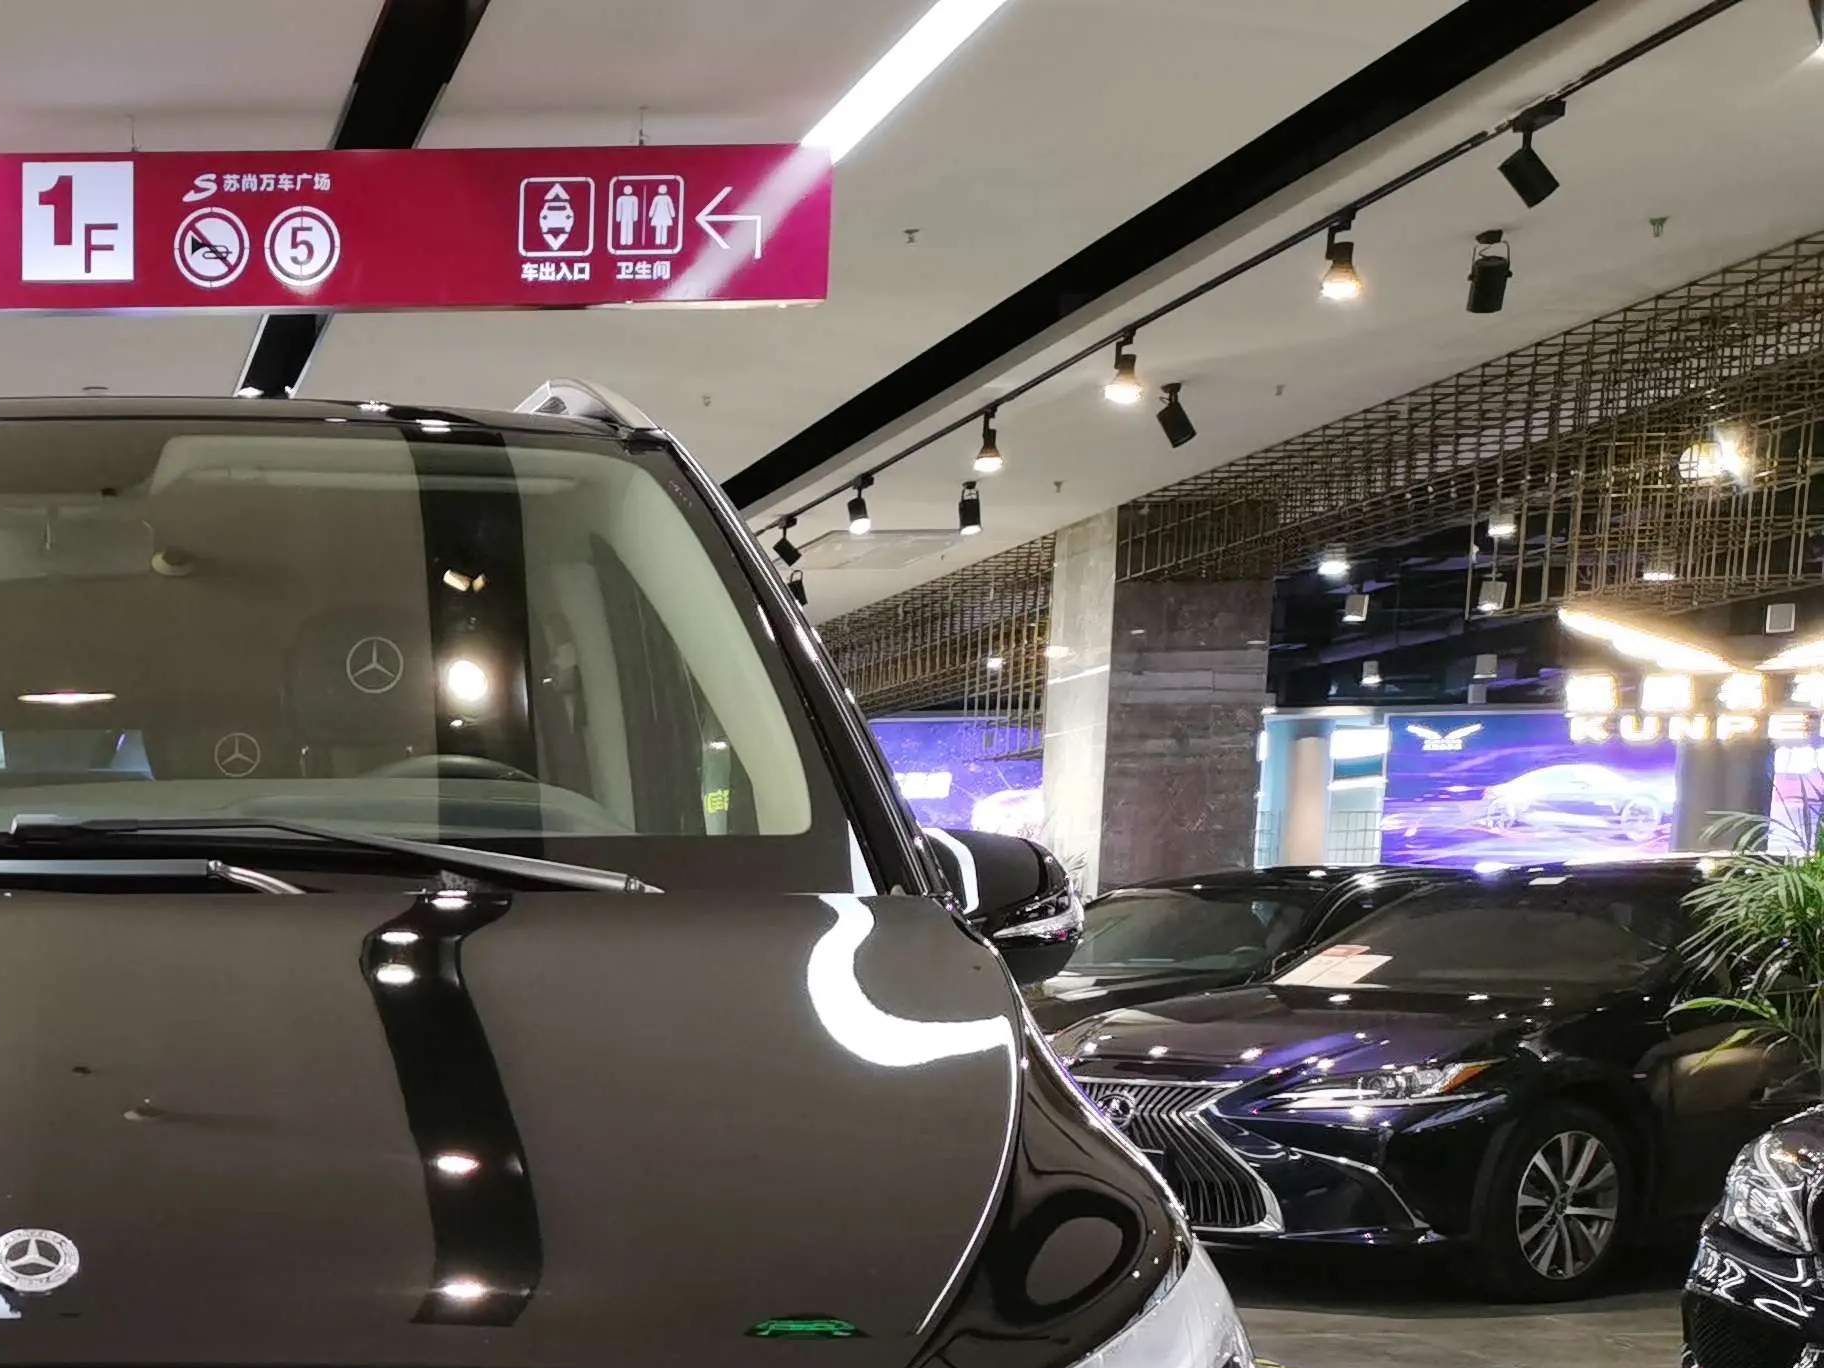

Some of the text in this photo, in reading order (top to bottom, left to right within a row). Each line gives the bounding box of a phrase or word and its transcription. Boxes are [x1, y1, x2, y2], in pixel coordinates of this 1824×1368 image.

[222, 173, 331, 193] 苏尚万车广场
[289, 226, 315, 266] 5
[520, 262, 591, 281] 车出入口
[615, 261, 671, 280] 卫生间
[1569, 713, 1824, 743] KUNPE
